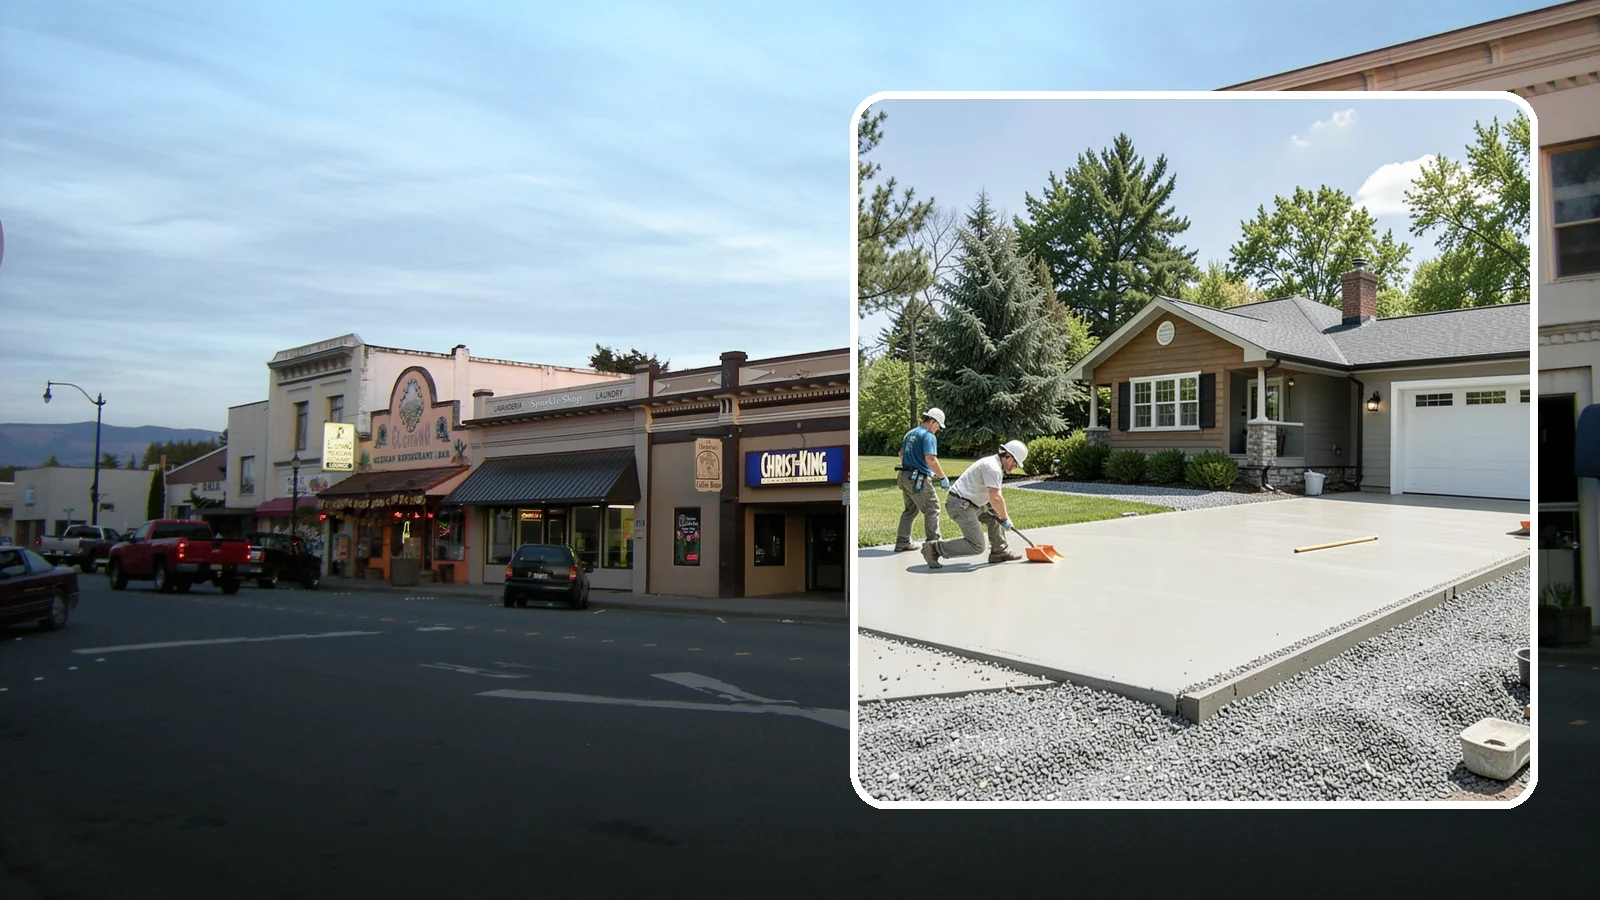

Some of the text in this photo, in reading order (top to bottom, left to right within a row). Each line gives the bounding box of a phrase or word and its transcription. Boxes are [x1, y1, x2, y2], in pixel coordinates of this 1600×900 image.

[531, 394, 583, 409] Sparkle Shop
[595, 389, 623, 400] LAUNDRY
[493, 402, 522, 412] LAVANDERIA
[373, 450, 450, 464] MEXICAN RESTAURANT BAR
[760, 450, 827, 478] CHRIST KING
